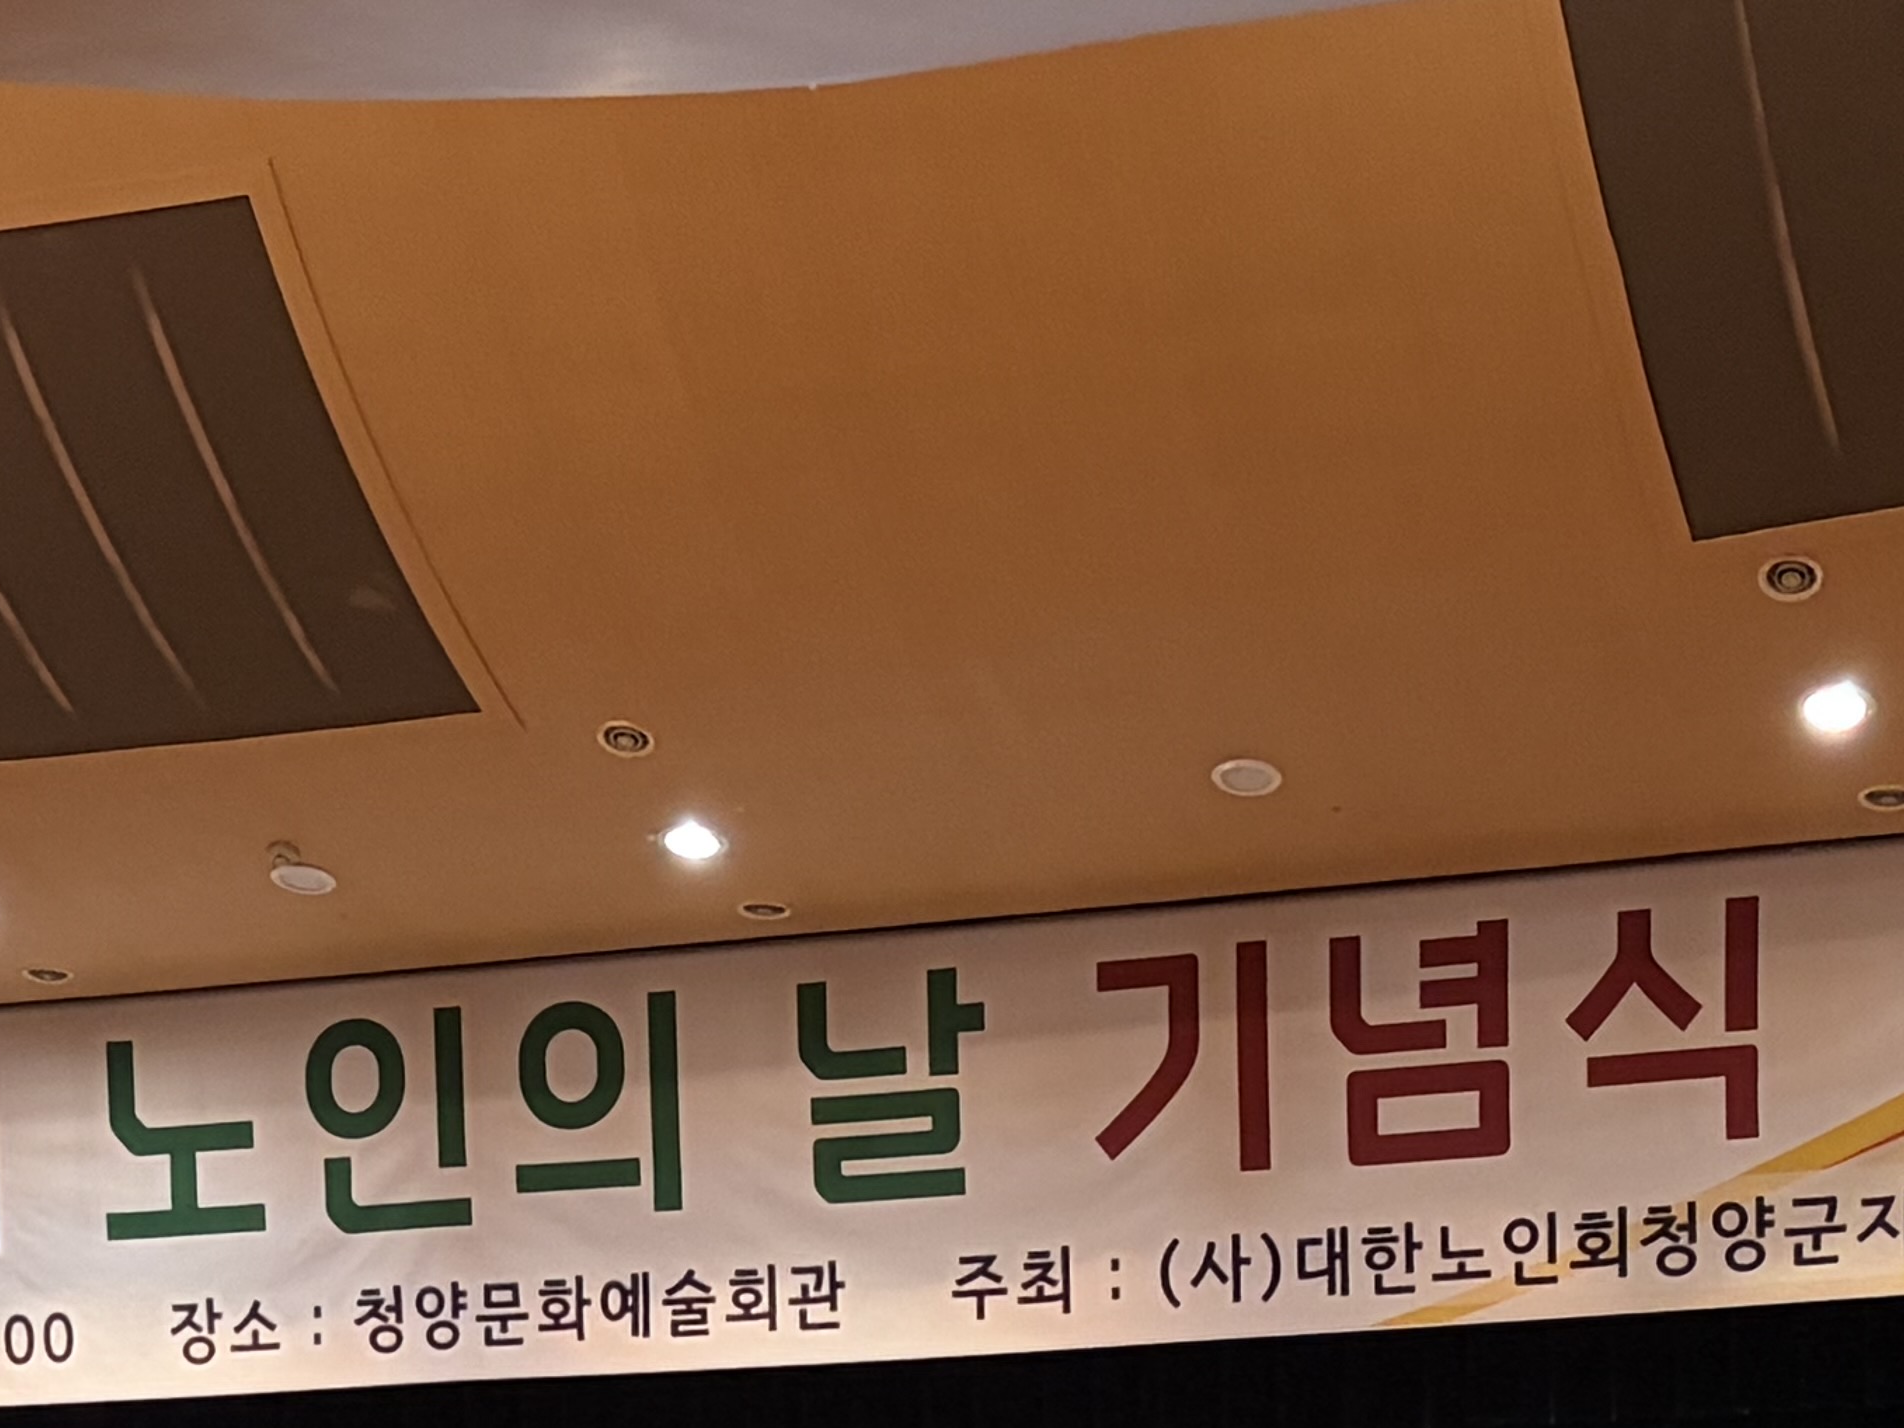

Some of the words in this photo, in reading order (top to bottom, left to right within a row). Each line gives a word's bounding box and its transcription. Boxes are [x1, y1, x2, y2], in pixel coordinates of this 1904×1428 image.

[104, 988, 686, 1241] 노인의
[795, 967, 987, 1205] 날
[1092, 894, 1763, 1174] 기념식
[169, 1296, 282, 1366] 장소
[353, 1260, 847, 1355] 청양문화예술회관
[950, 1245, 1072, 1318] 주최
